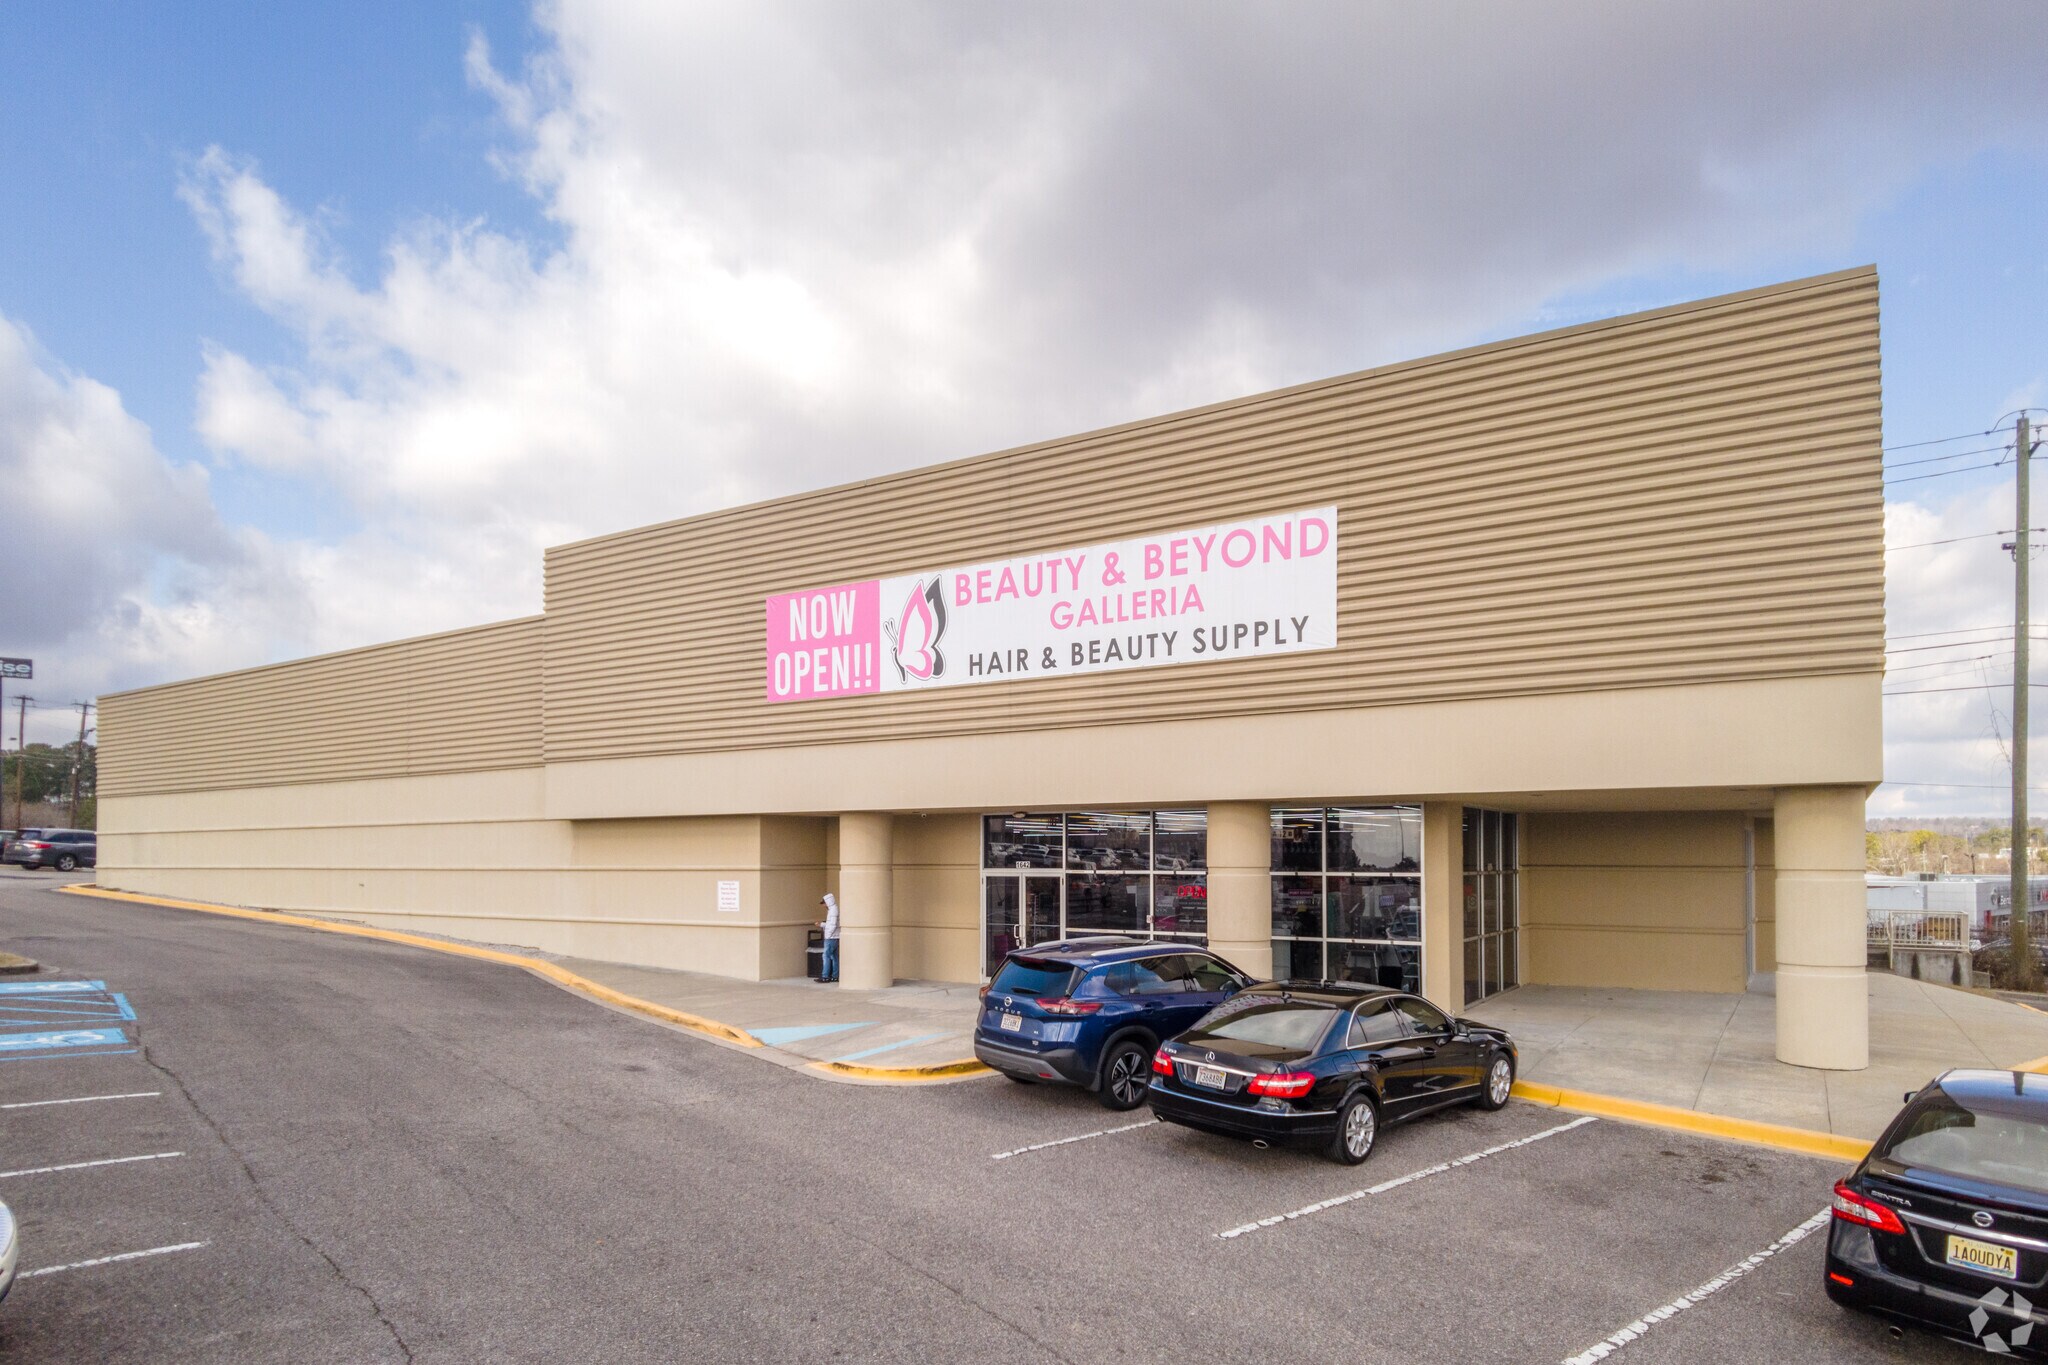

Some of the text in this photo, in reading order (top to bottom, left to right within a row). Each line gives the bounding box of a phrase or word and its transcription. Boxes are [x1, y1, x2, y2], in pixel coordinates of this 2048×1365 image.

[955, 517, 1329, 607] BEAUTY & BEYOND
[789, 590, 857, 642] NOW
[1050, 583, 1205, 630] GALLERIA
[774, 642, 872, 696] OPEN!!
[969, 615, 1309, 676] HAIR & BEAUTY SUPPLY
[1177, 885, 1207, 899] OPEN
[1871, 1190, 1912, 1207] SENTRA
